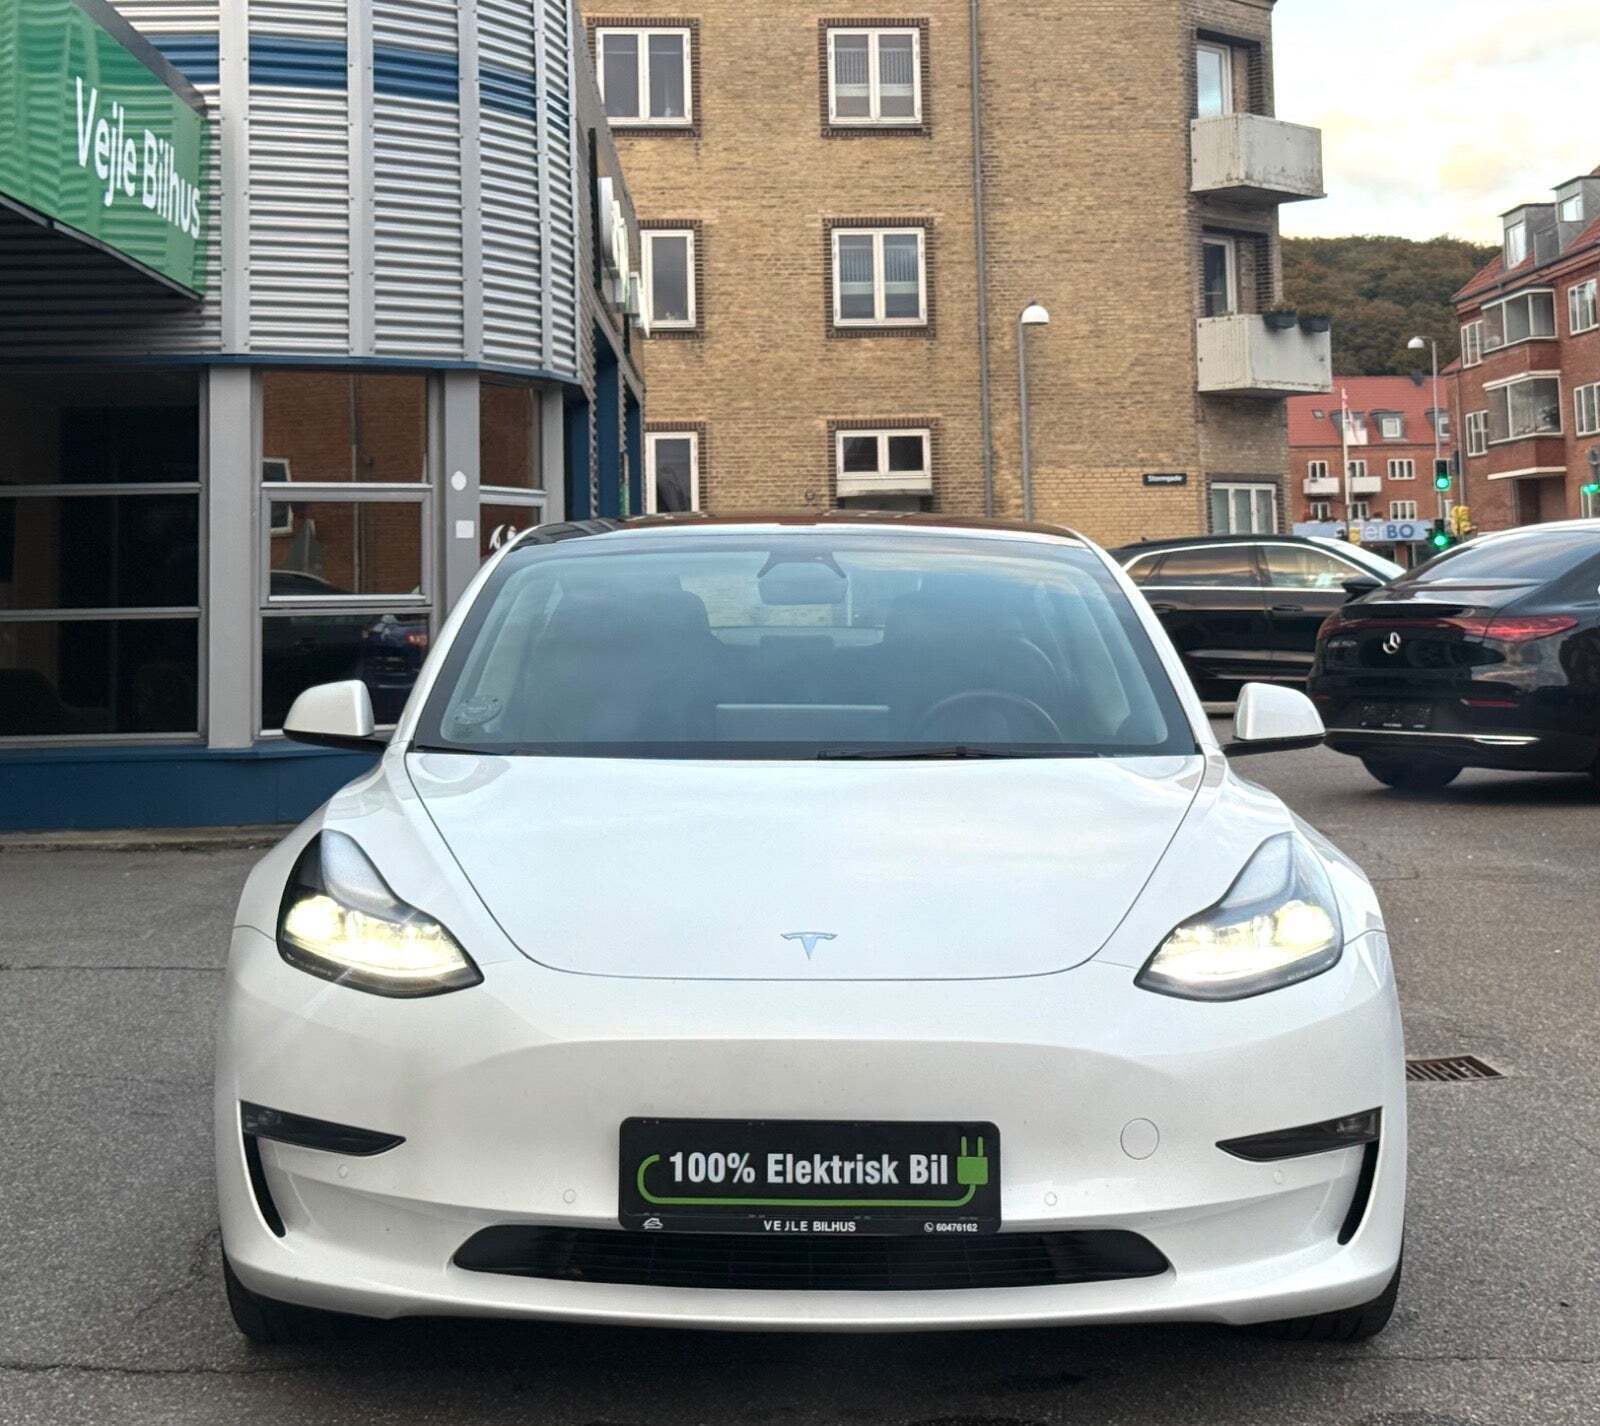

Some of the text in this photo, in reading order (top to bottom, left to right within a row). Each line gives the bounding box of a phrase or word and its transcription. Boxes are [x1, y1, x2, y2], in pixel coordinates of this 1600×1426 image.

[76, 76, 200, 239] Vejle Bilhus
[669, 1152, 948, 1185] 100% Elektrisk Bil
[763, 1220, 856, 1232] VEJLE BILHUS
[936, 1223, 979, 1233] 60476162
